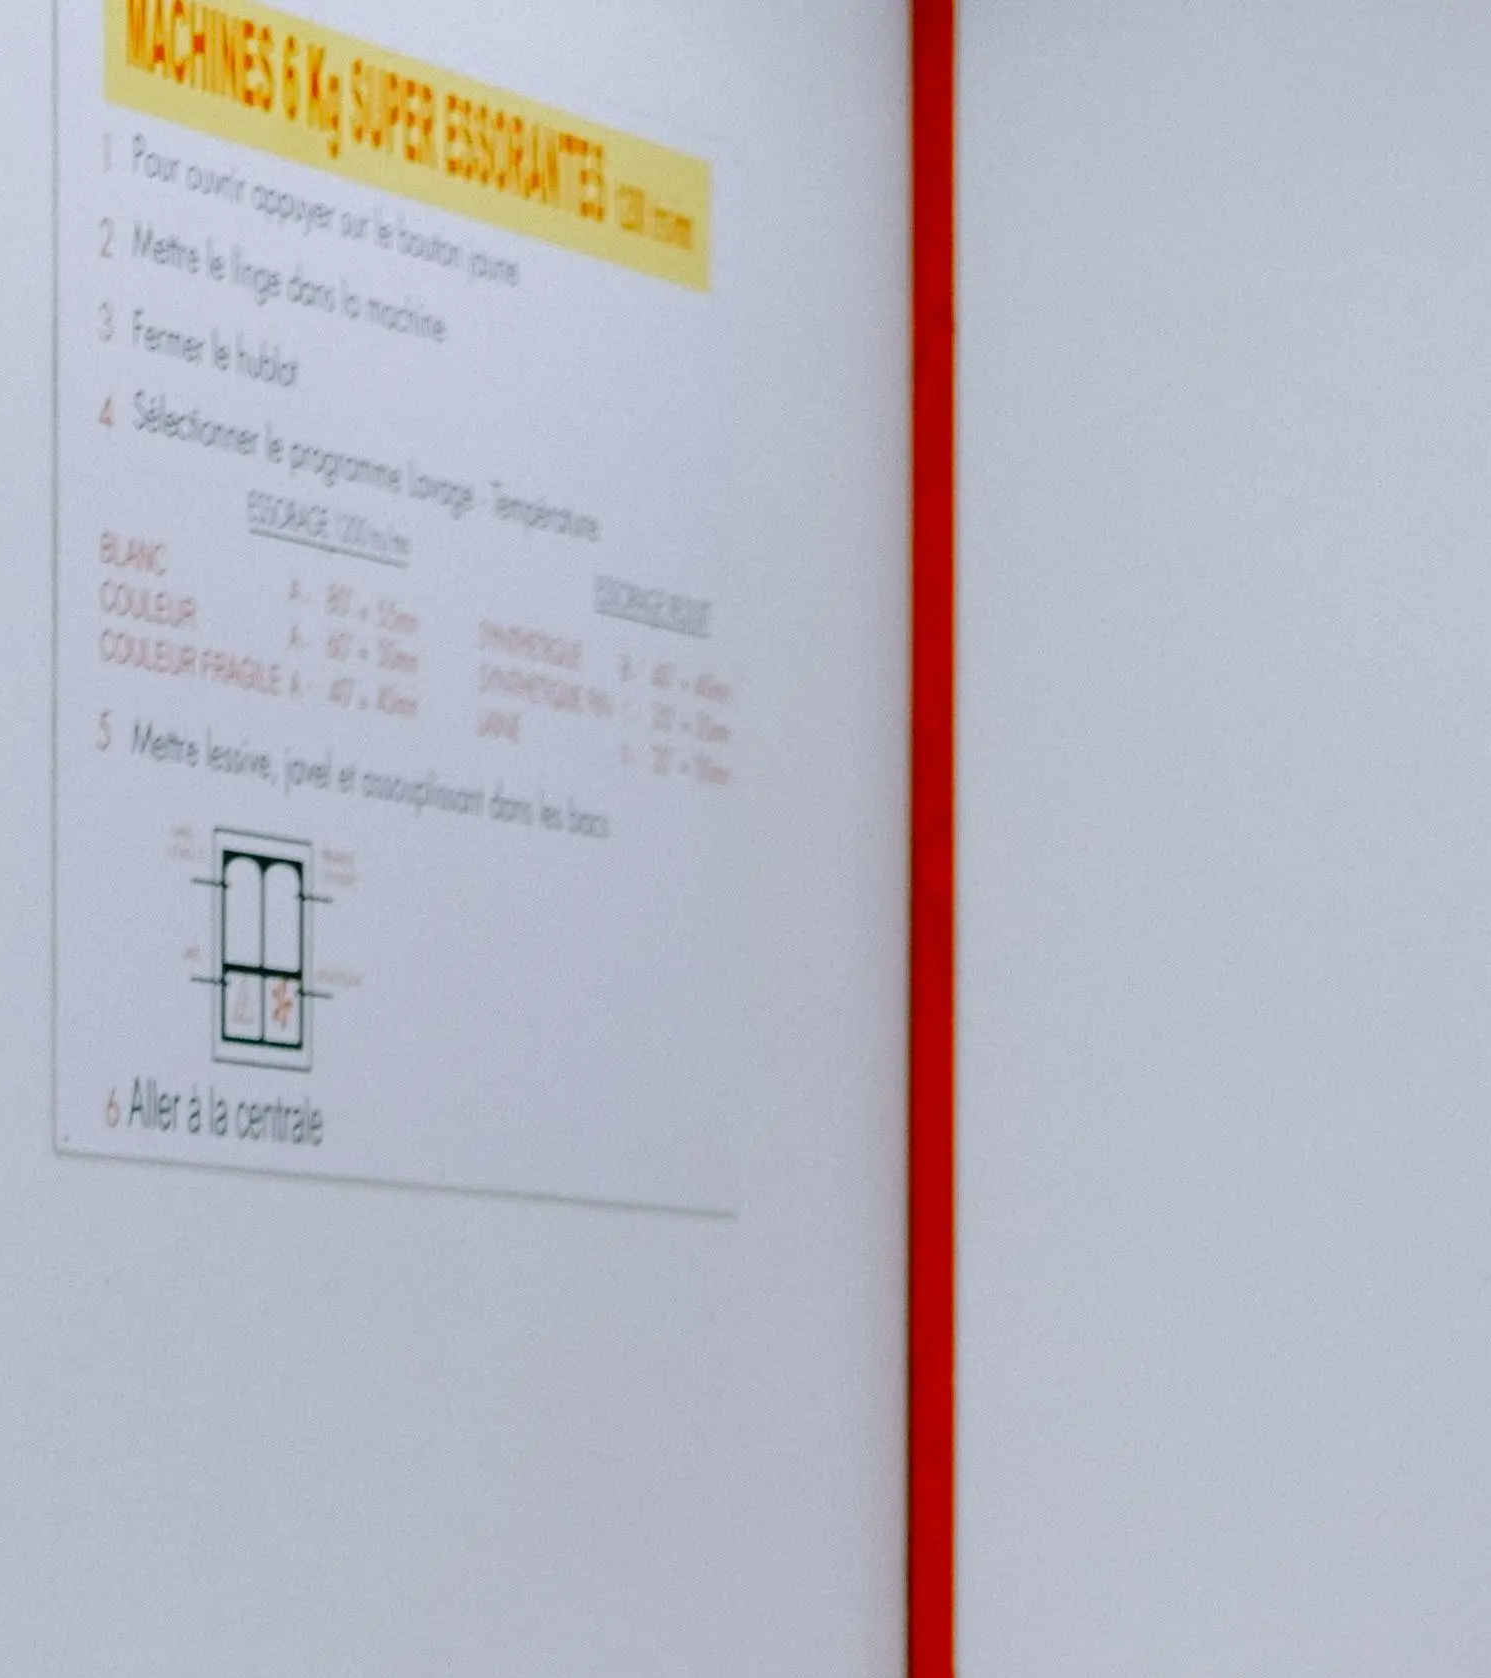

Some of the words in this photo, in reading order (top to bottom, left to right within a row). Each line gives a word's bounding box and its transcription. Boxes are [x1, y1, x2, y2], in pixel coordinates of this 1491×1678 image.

[126, 0, 273, 113] MACHINES
[128, 1076, 181, 1131] Aller
[210, 1084, 228, 1136] la
[236, 1095, 324, 1146] centrale
